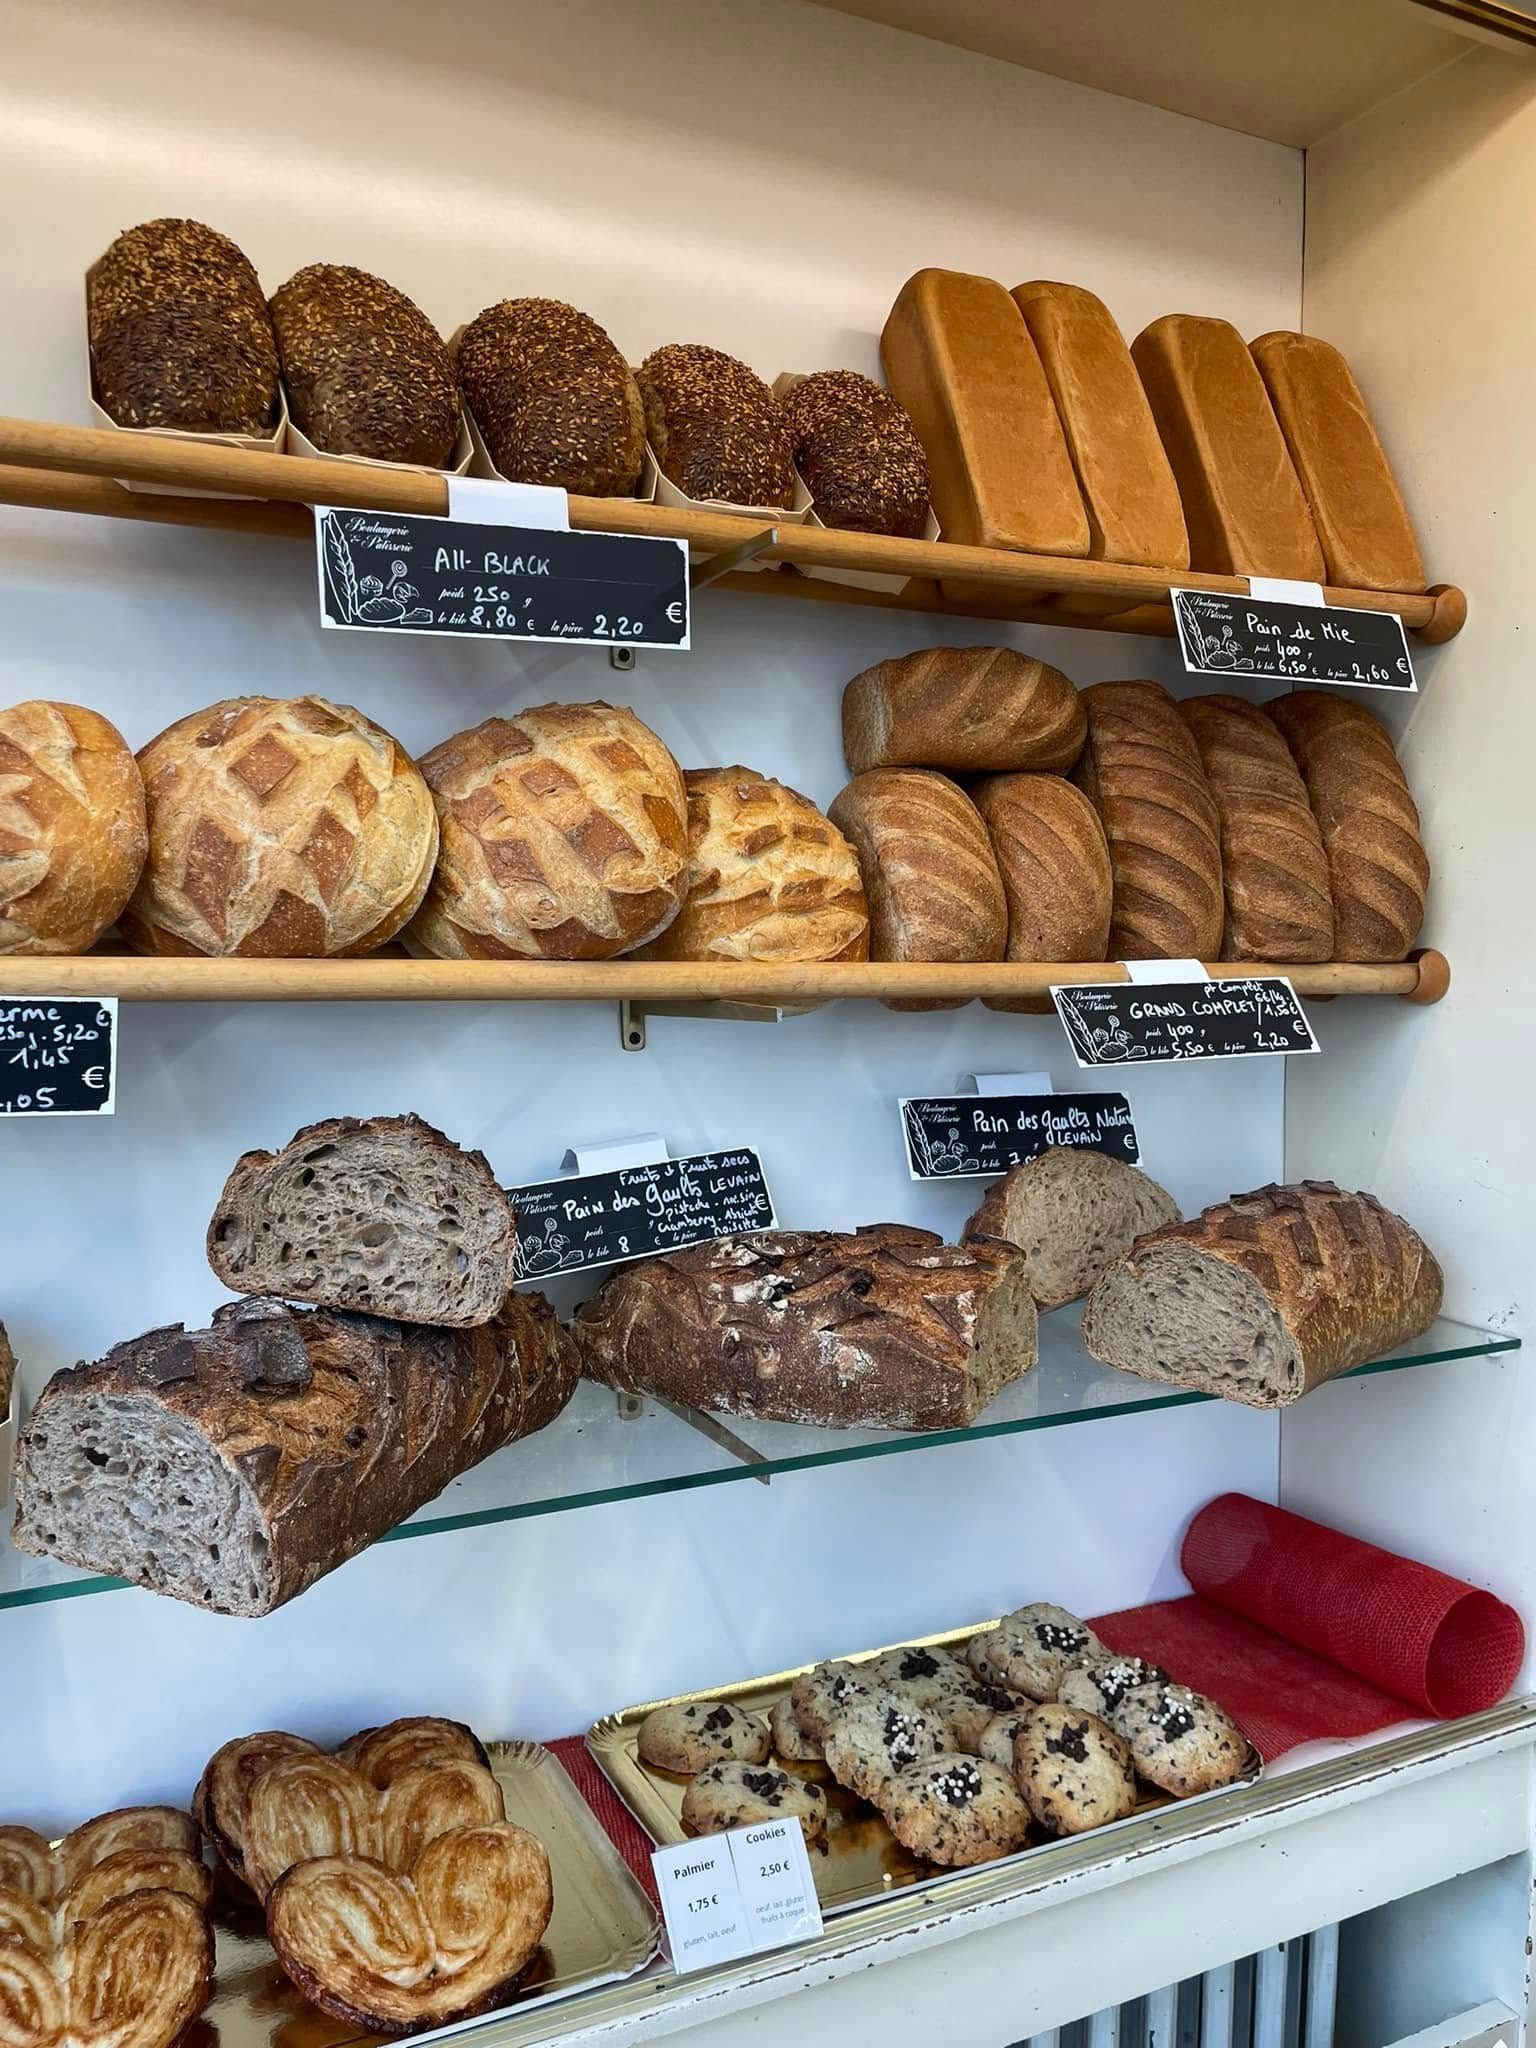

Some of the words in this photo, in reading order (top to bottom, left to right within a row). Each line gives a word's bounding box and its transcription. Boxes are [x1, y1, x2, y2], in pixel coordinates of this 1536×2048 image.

[345, 517, 409, 539] Boulangerie
[484, 552, 550, 575] BLACK
[438, 586, 464, 600] poids
[473, 586, 510, 602] 250
[438, 611, 447, 623] le
[449, 612, 467, 624] kilo
[469, 605, 516, 629] 8,80
[527, 619, 535, 630] €
[550, 620, 559, 632] la
[593, 614, 643, 638] 2,20
[665, 602, 683, 623] €
[1246, 612, 1281, 635] Pain
[1289, 621, 1315, 640] de
[1321, 622, 1355, 643] Mie
[1277, 639, 1301, 660] 400
[1279, 658, 1307, 675] 6,50
[1352, 663, 1389, 682] 2,60
[1396, 657, 1408, 673] €
[1130, 1002, 1185, 1019] GRAND
[1192, 999, 1255, 1016] COMPLET
[53, 1024, 99, 1044] 5,20
[1166, 1024, 1193, 1042] 400
[1172, 1041, 1204, 1059] 5,50
[1253, 1031, 1289, 1050] 2,20
[1293, 1020, 1307, 1035] €
[81, 1066, 104, 1088] €
[973, 1109, 1009, 1133] Pain
[1017, 1111, 1038, 1130] des
[1124, 1134, 1135, 1149] €
[619, 1167, 661, 1186] Fruits
[679, 1156, 718, 1174] Fruits
[612, 1190, 640, 1212] des
[754, 1193, 769, 1211] €
[618, 1236, 630, 1253] 8
[746, 1828, 786, 1844] Cookies
[674, 1860, 715, 1879] Palmier
[760, 1863, 781, 1877] 2,50
[783, 1860, 790, 1870] €
[712, 1894, 718, 1905] €
